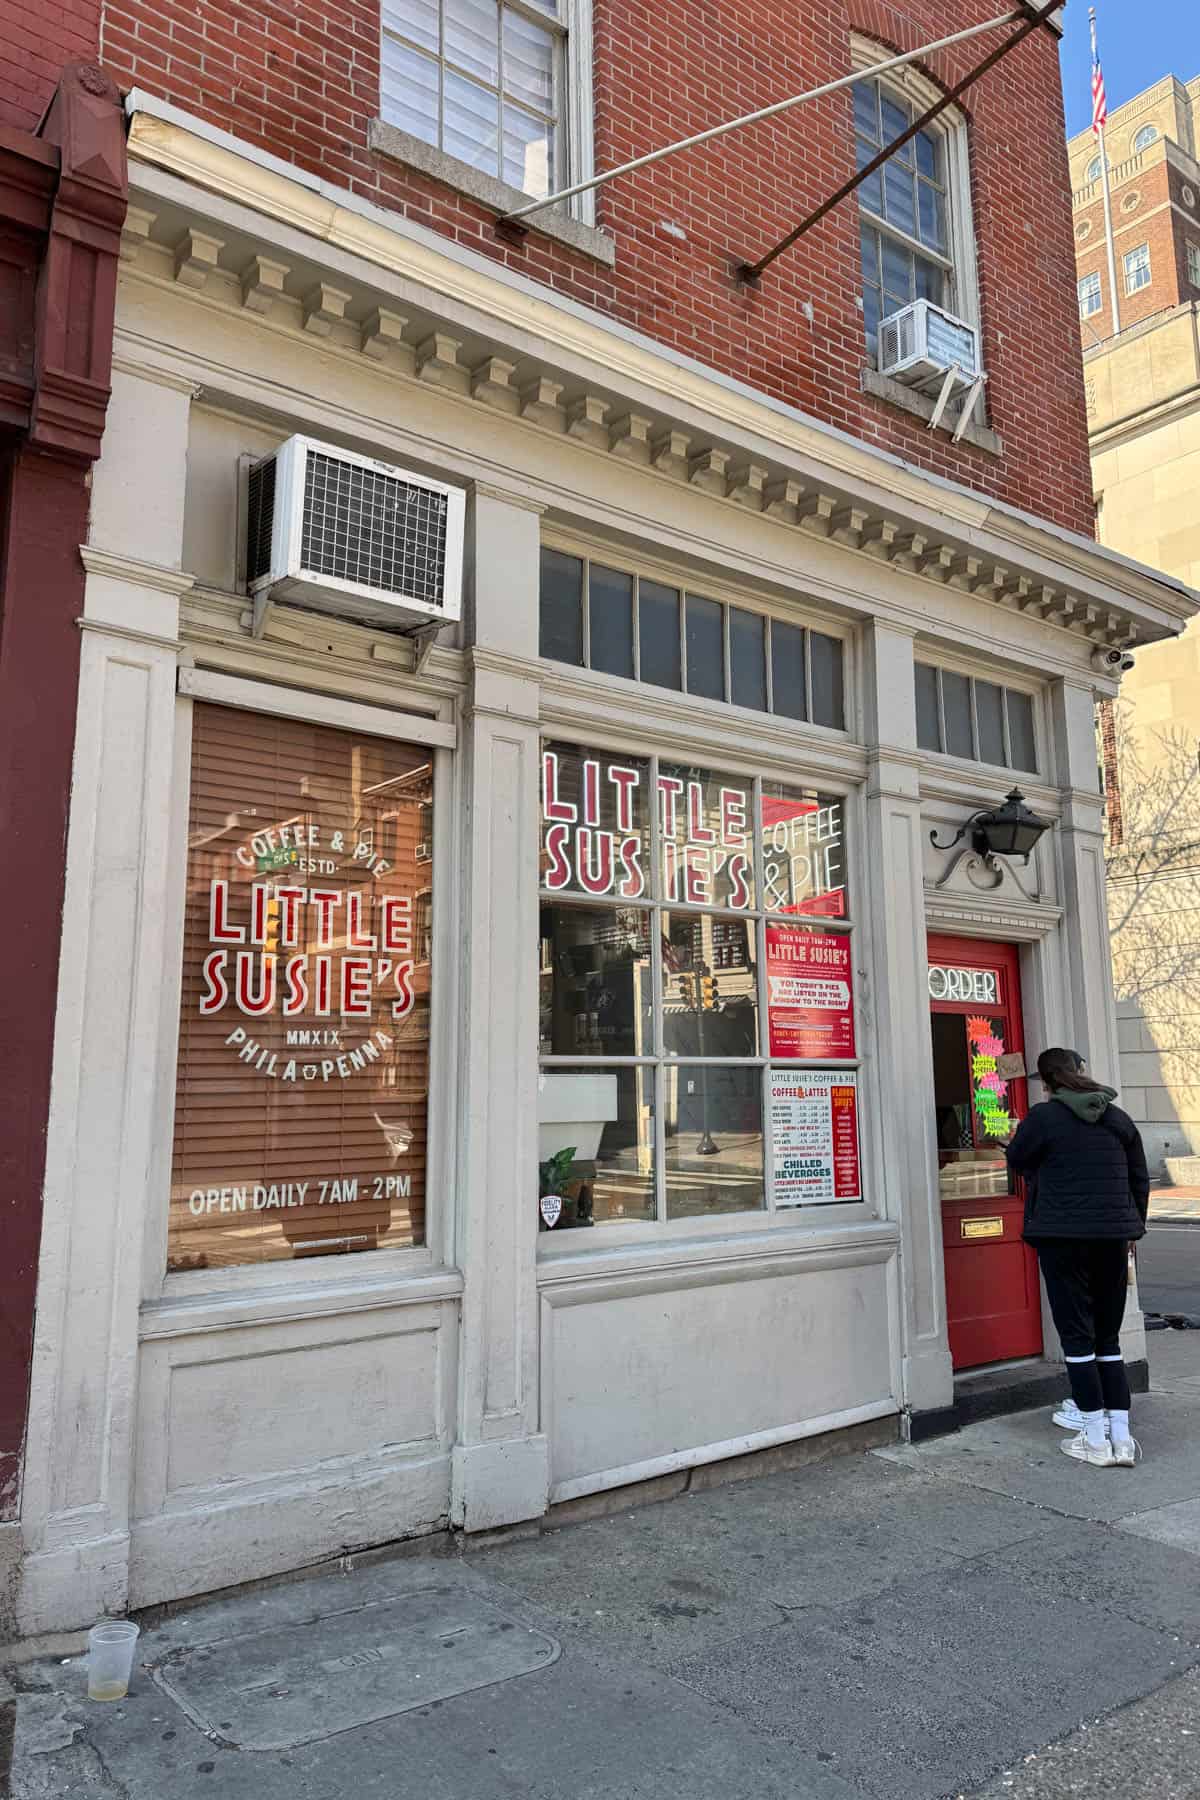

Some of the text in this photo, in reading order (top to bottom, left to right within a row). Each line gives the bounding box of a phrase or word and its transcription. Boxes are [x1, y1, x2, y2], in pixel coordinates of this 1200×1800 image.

[542, 752, 747, 849] LITTLE
[236, 825, 320, 867] COFFEE
[330, 830, 344, 853] &
[352, 843, 394, 880] PIE
[762, 804, 841, 858] COFFEE
[545, 824, 750, 910] SUSIE'S
[763, 842, 846, 910] & PIE
[209, 879, 412, 953] LITTLE
[768, 943, 848, 965] LITTLE SUSIE'S
[199, 949, 415, 1018] SUSIE'S
[928, 966, 996, 1003] ORDER
[225, 1026, 394, 1082] PHILA PENNA
[286, 1030, 339, 1046] MMXIX
[771, 1074, 790, 1082] LITTLE
[772, 1087, 797, 1096] COFFEE
[804, 1087, 828, 1096] LATTES
[775, 1168, 831, 1179] BEVERAGES
[784, 1160, 822, 1168] CHILLED
[189, 1186, 247, 1216] OPEN
[253, 1182, 309, 1211] DAILY
